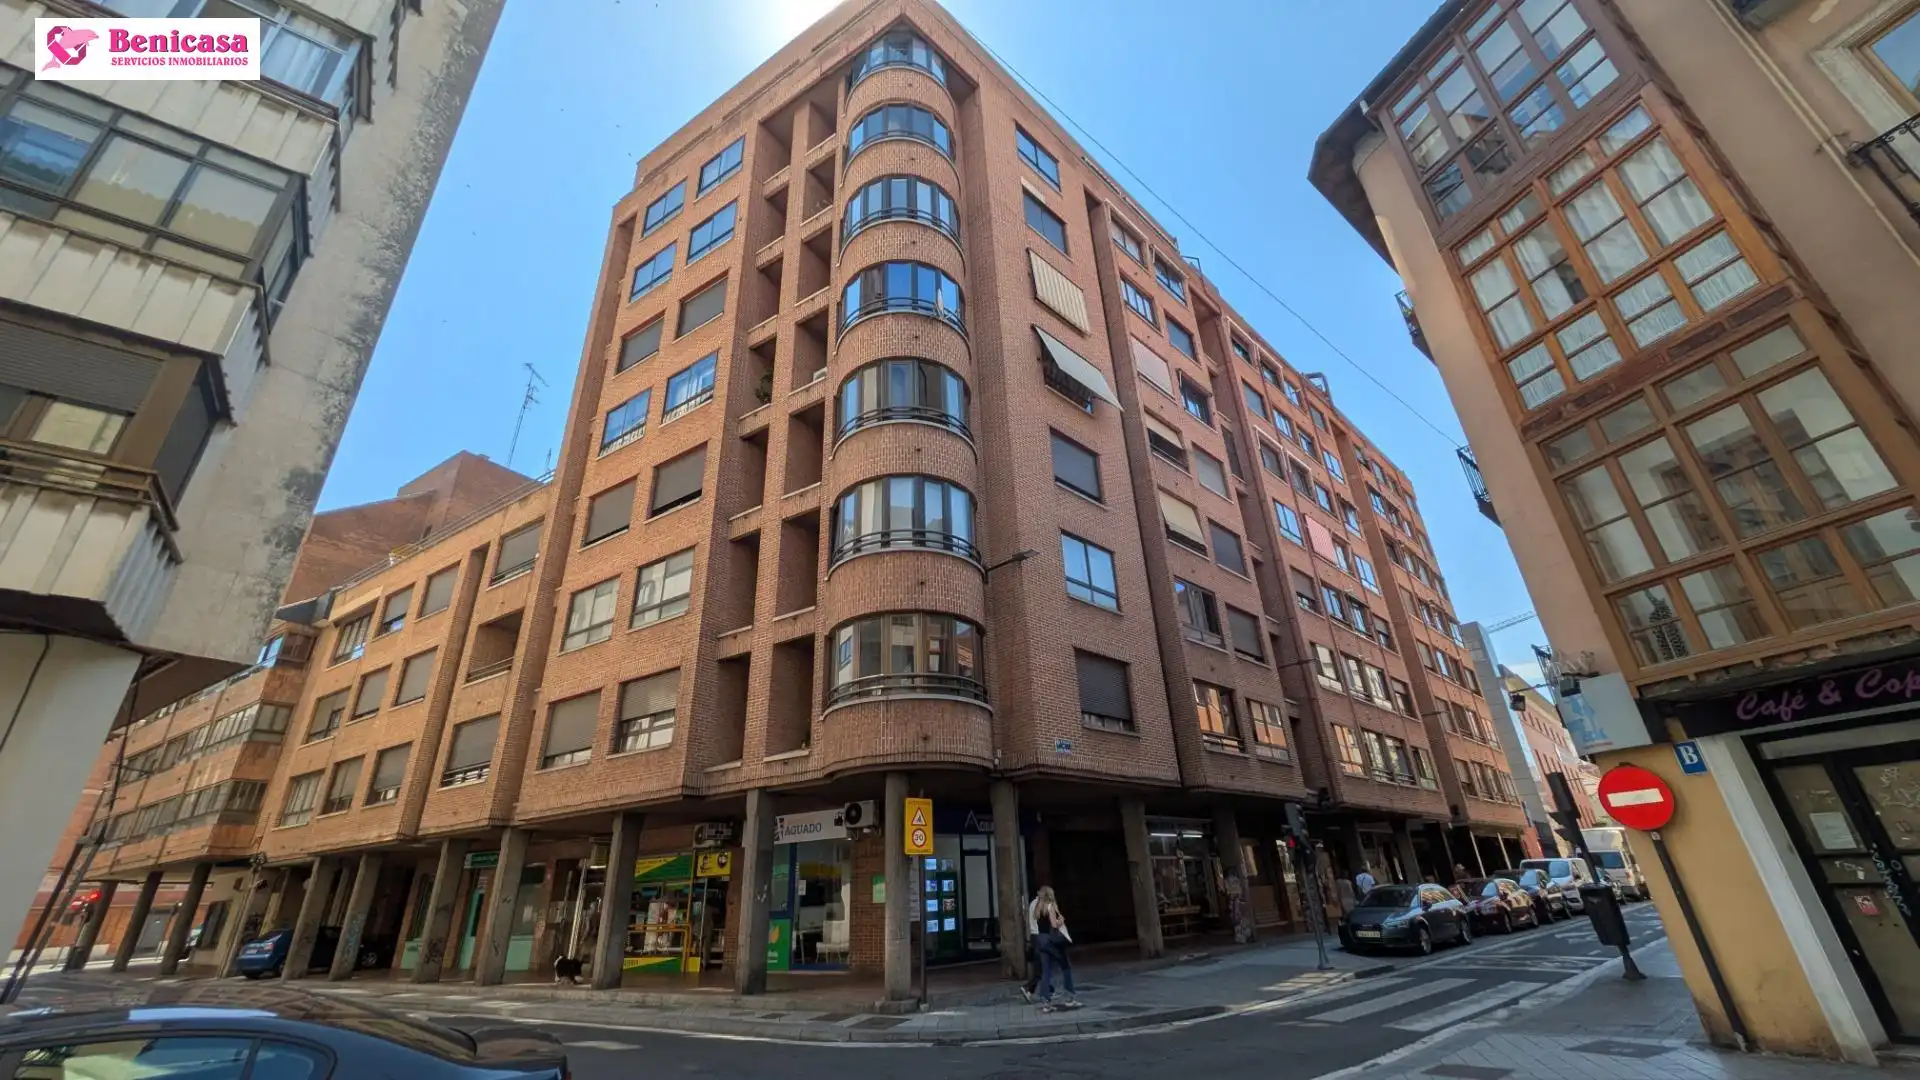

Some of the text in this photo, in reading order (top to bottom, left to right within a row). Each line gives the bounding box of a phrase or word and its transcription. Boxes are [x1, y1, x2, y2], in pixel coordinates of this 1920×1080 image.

[1736, 691, 1808, 721] Café
[1818, 680, 1842, 705] &
[1676, 745, 1698, 765] B
[914, 833, 924, 841] 30
